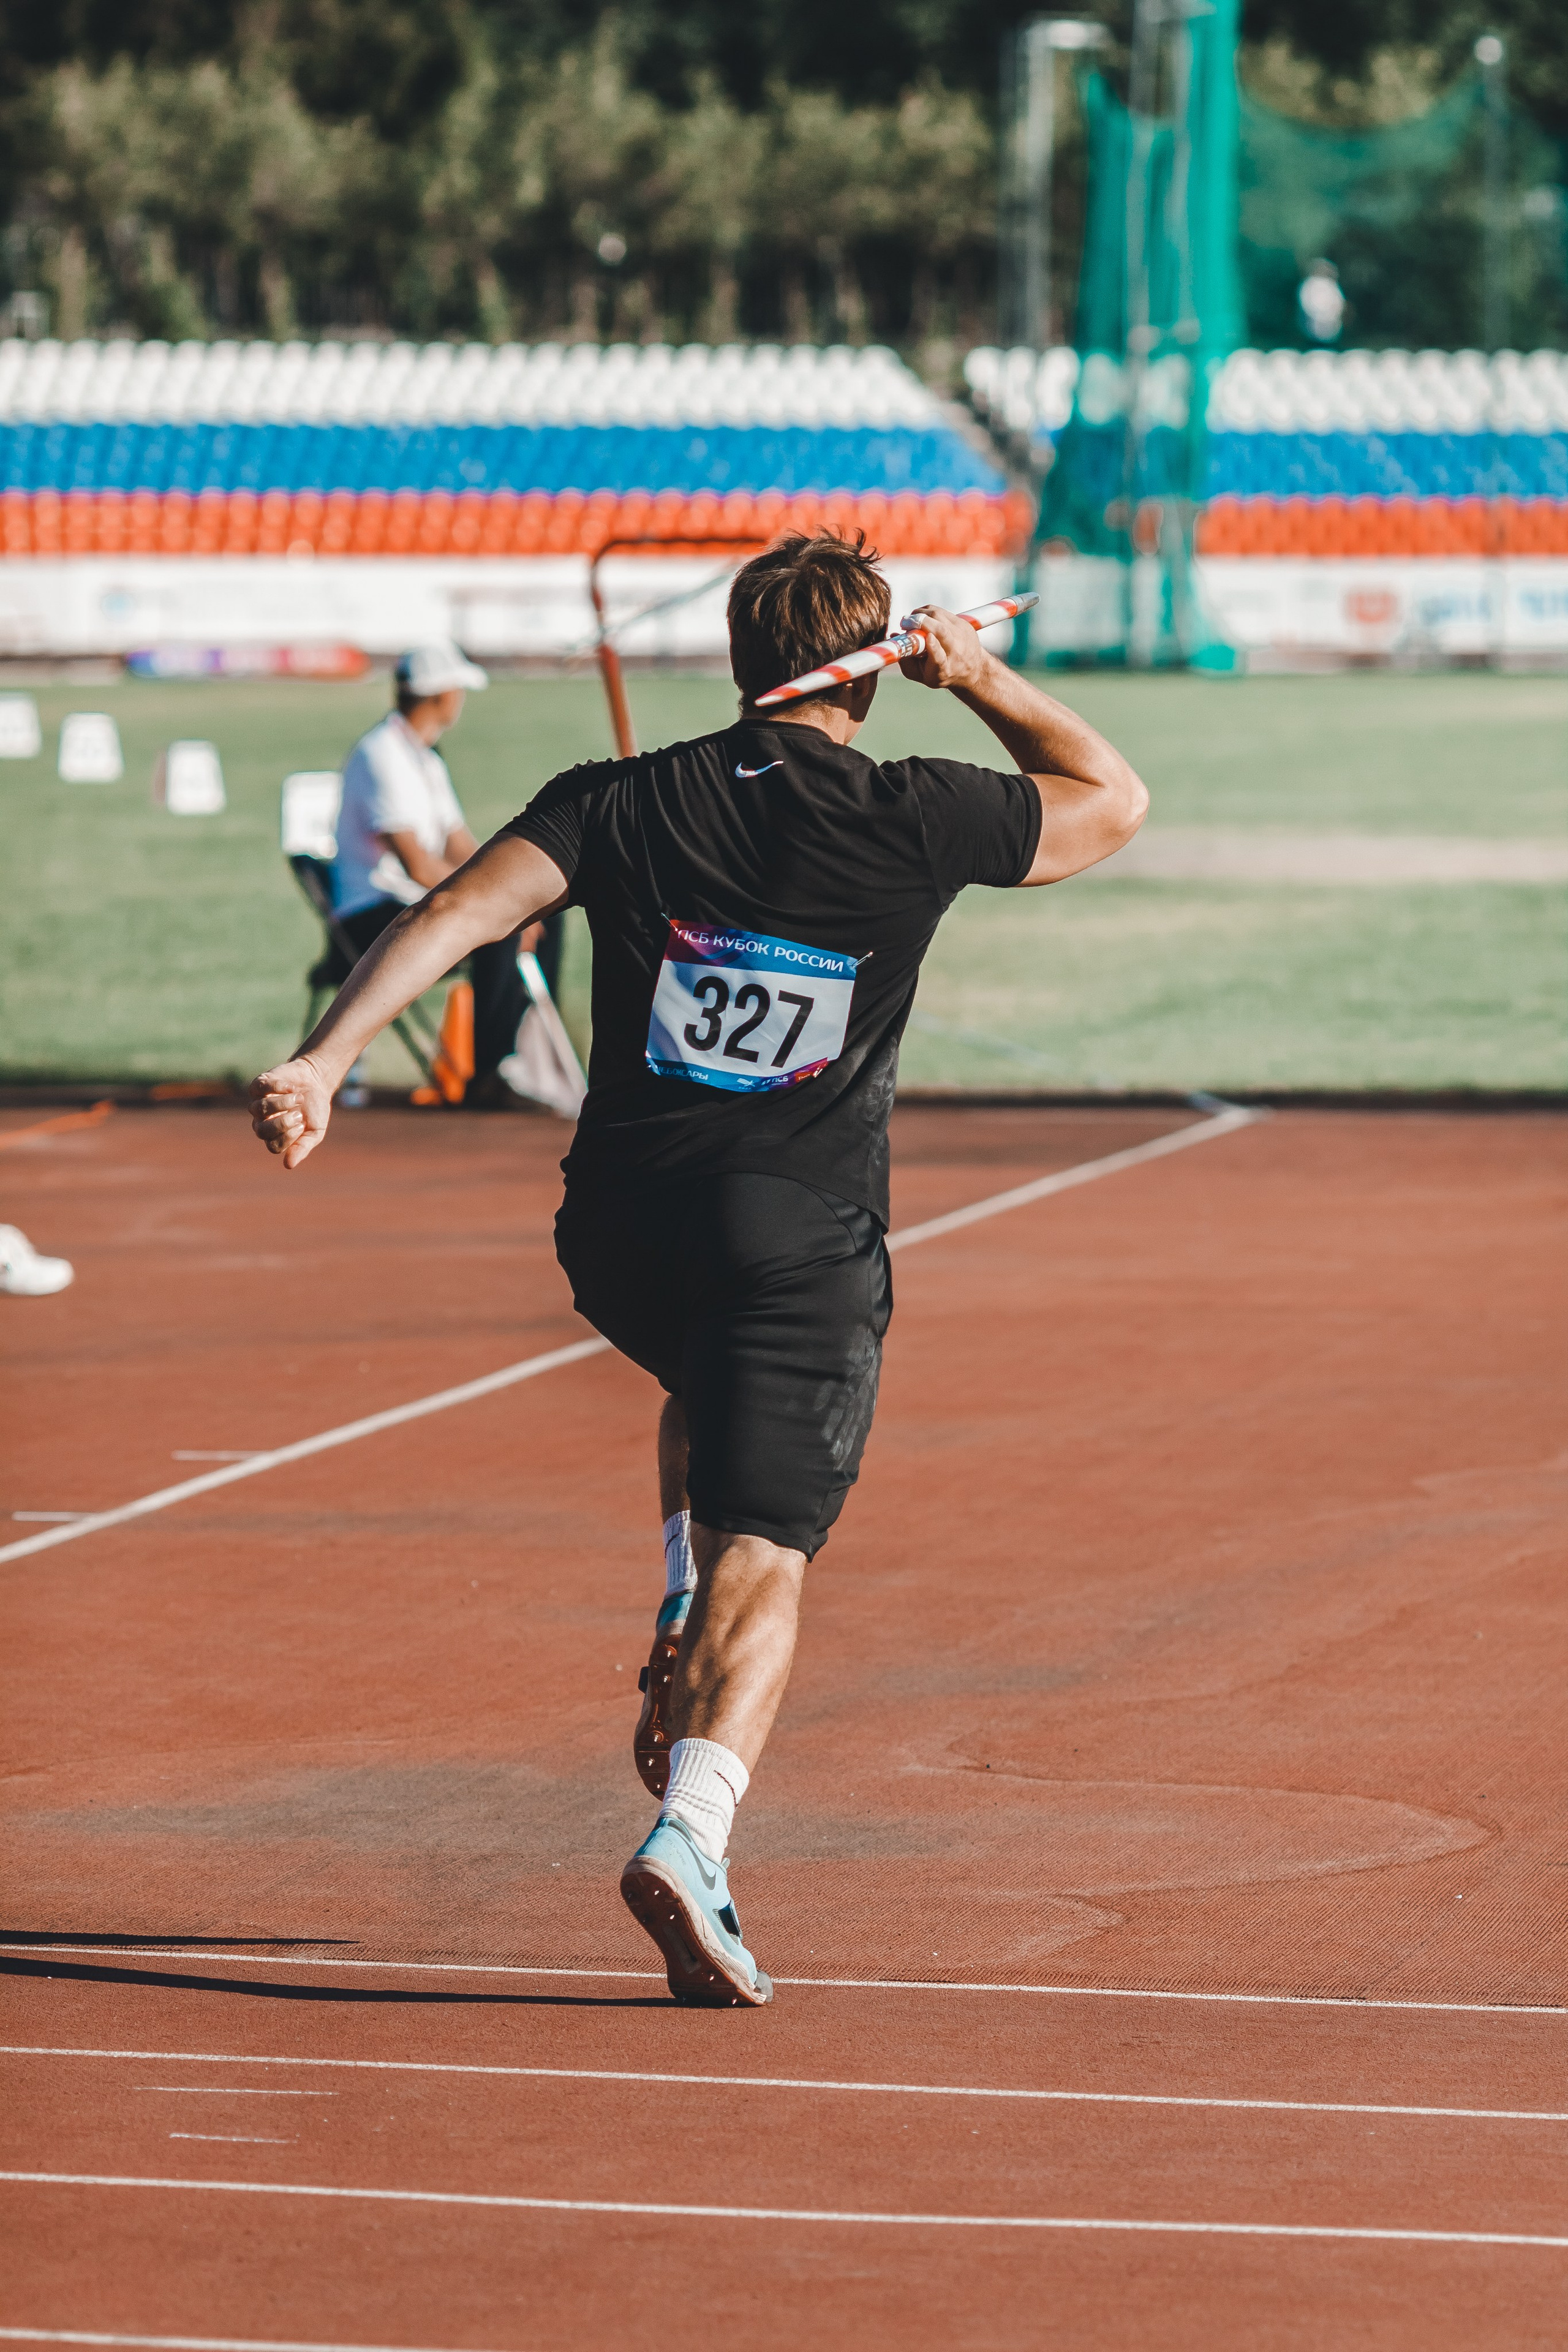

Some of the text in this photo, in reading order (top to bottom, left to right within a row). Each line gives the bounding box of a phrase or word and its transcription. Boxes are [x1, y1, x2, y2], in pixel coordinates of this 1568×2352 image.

[713, 935, 769, 955] КУБОК
[774, 946, 843, 972] РОССИИ
[684, 976, 815, 1069] 327
